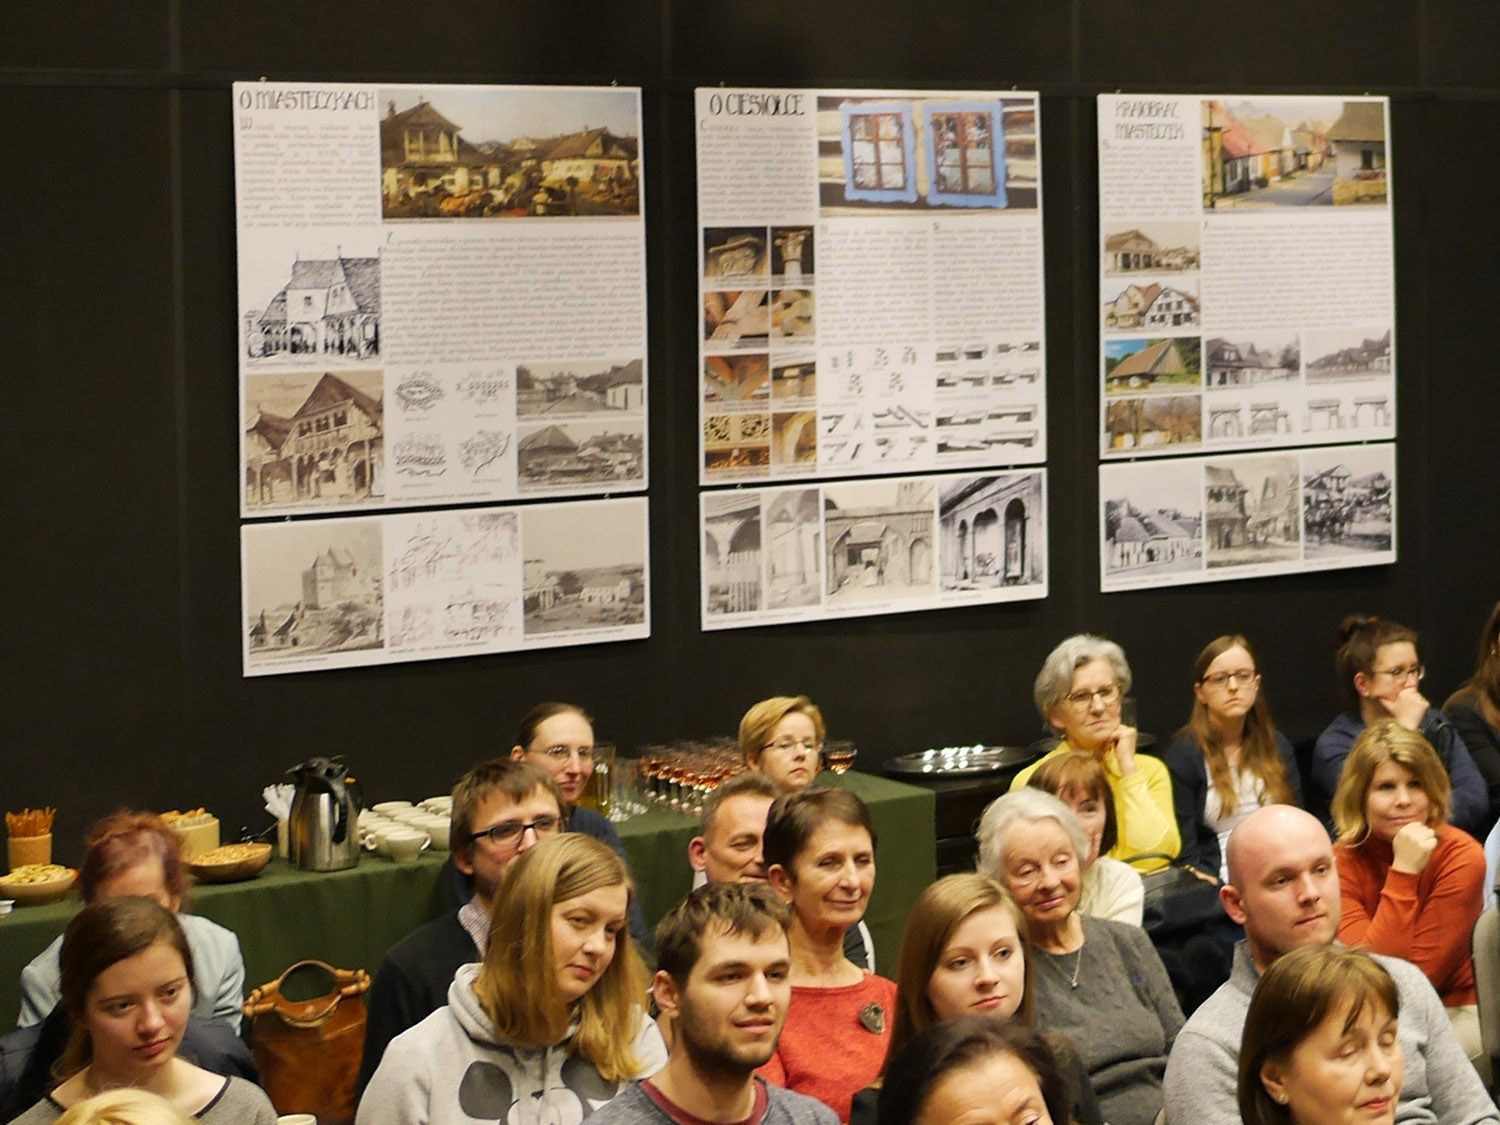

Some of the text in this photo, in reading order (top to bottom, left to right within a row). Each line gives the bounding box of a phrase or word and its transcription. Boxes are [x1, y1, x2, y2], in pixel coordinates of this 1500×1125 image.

[239, 89, 375, 111] O MIASTECZKACH
[709, 93, 723, 116] O
